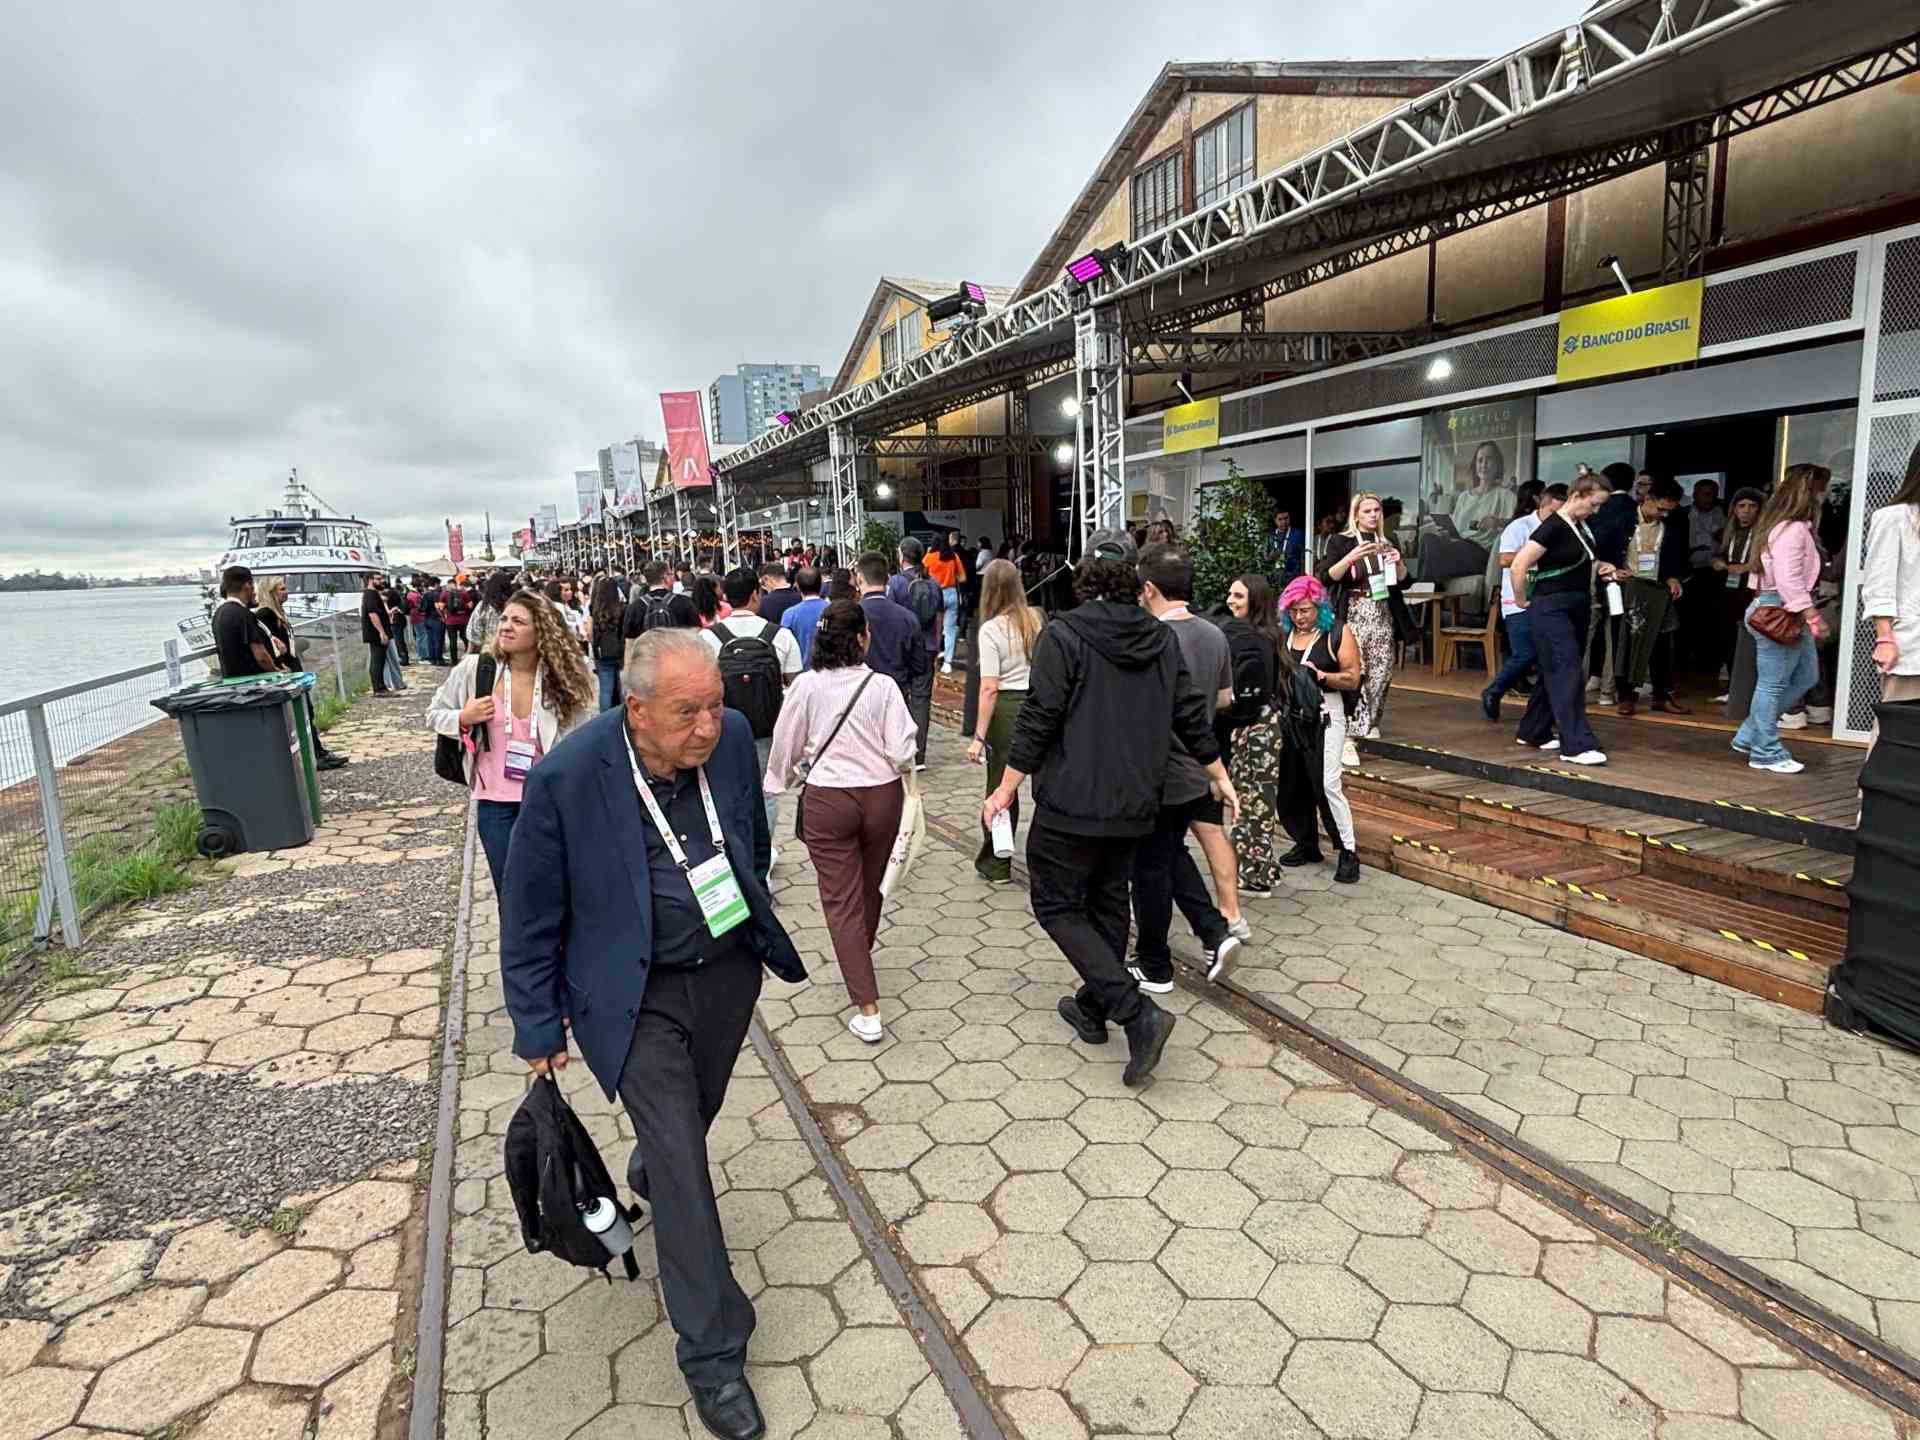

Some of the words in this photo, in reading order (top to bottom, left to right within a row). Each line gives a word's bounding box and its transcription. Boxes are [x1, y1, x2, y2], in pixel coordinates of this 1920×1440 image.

[1582, 331, 1624, 349] BANCO
[1625, 326, 1643, 341] DO
[1645, 317, 1689, 336] BRASIL
[280, 549, 324, 560] ALEGRE
